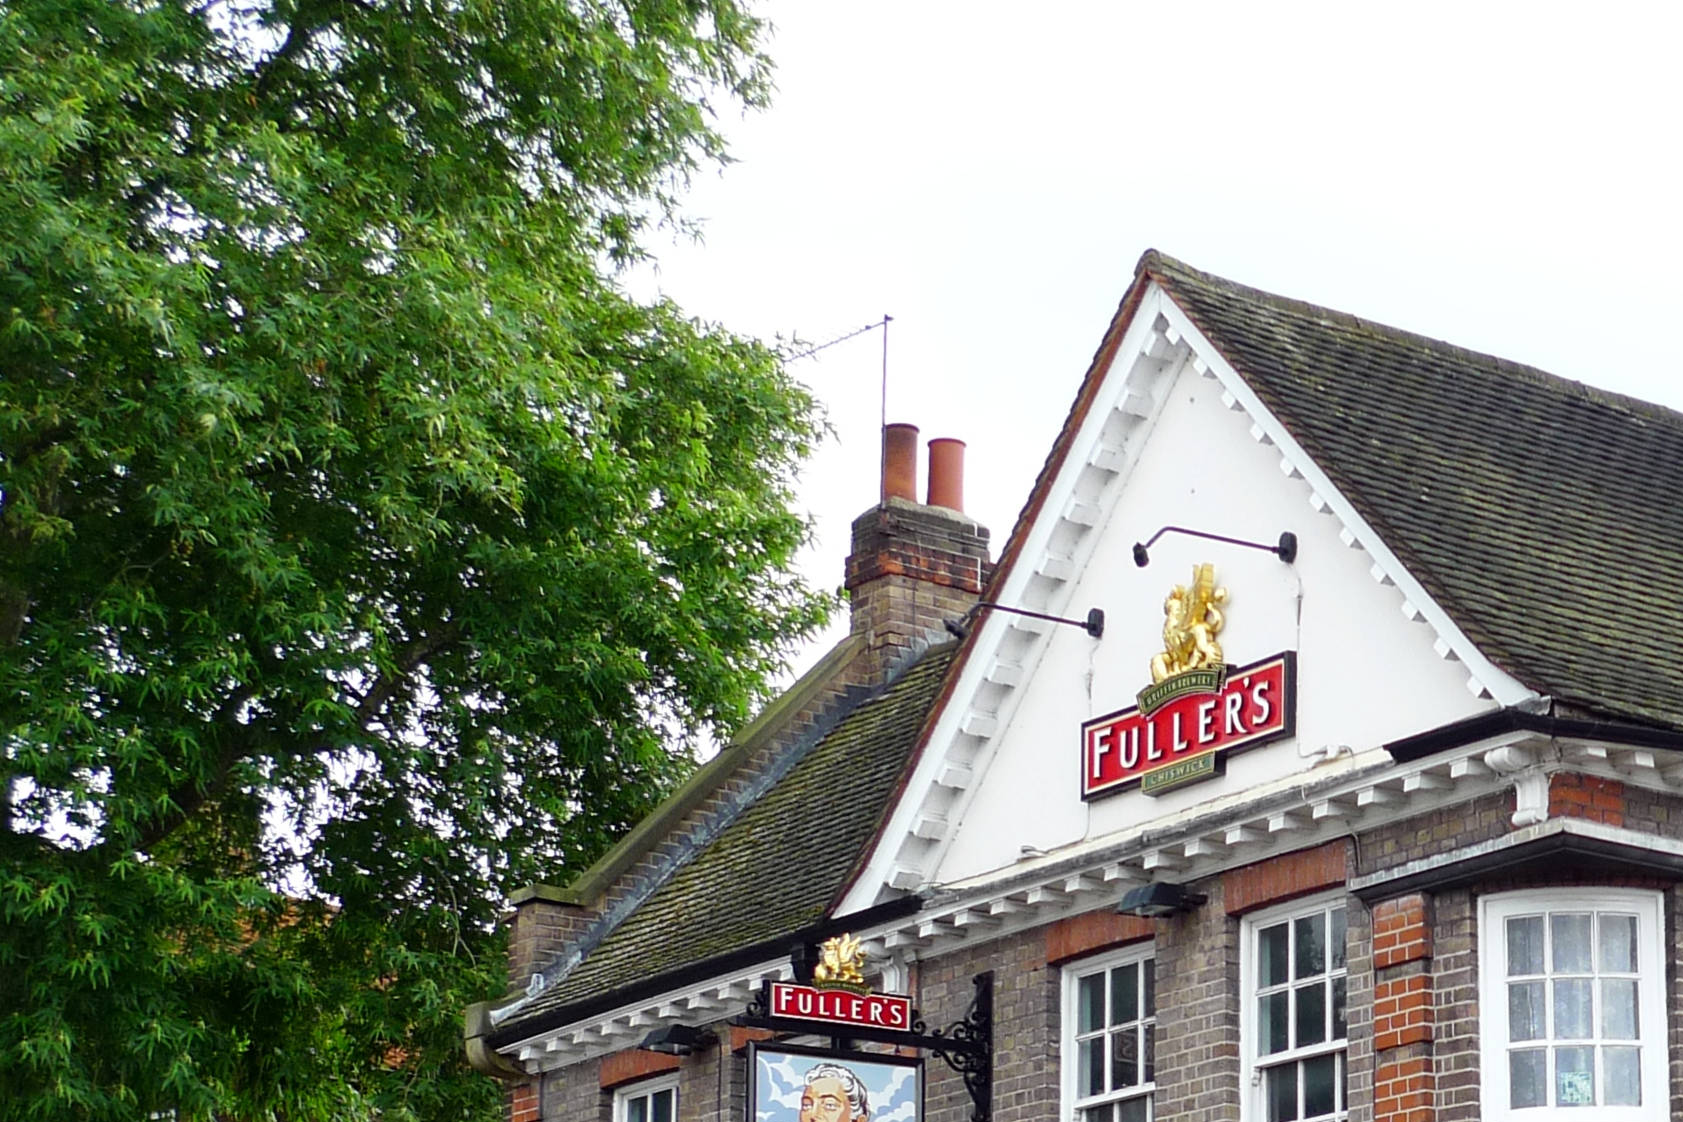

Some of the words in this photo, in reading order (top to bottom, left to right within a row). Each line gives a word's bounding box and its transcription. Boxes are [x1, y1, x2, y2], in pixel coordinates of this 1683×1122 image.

[1093, 677, 1270, 778] FULLER'S
[1150, 758, 1207, 785] CHISWICK
[779, 987, 903, 1025] FULLER'S
